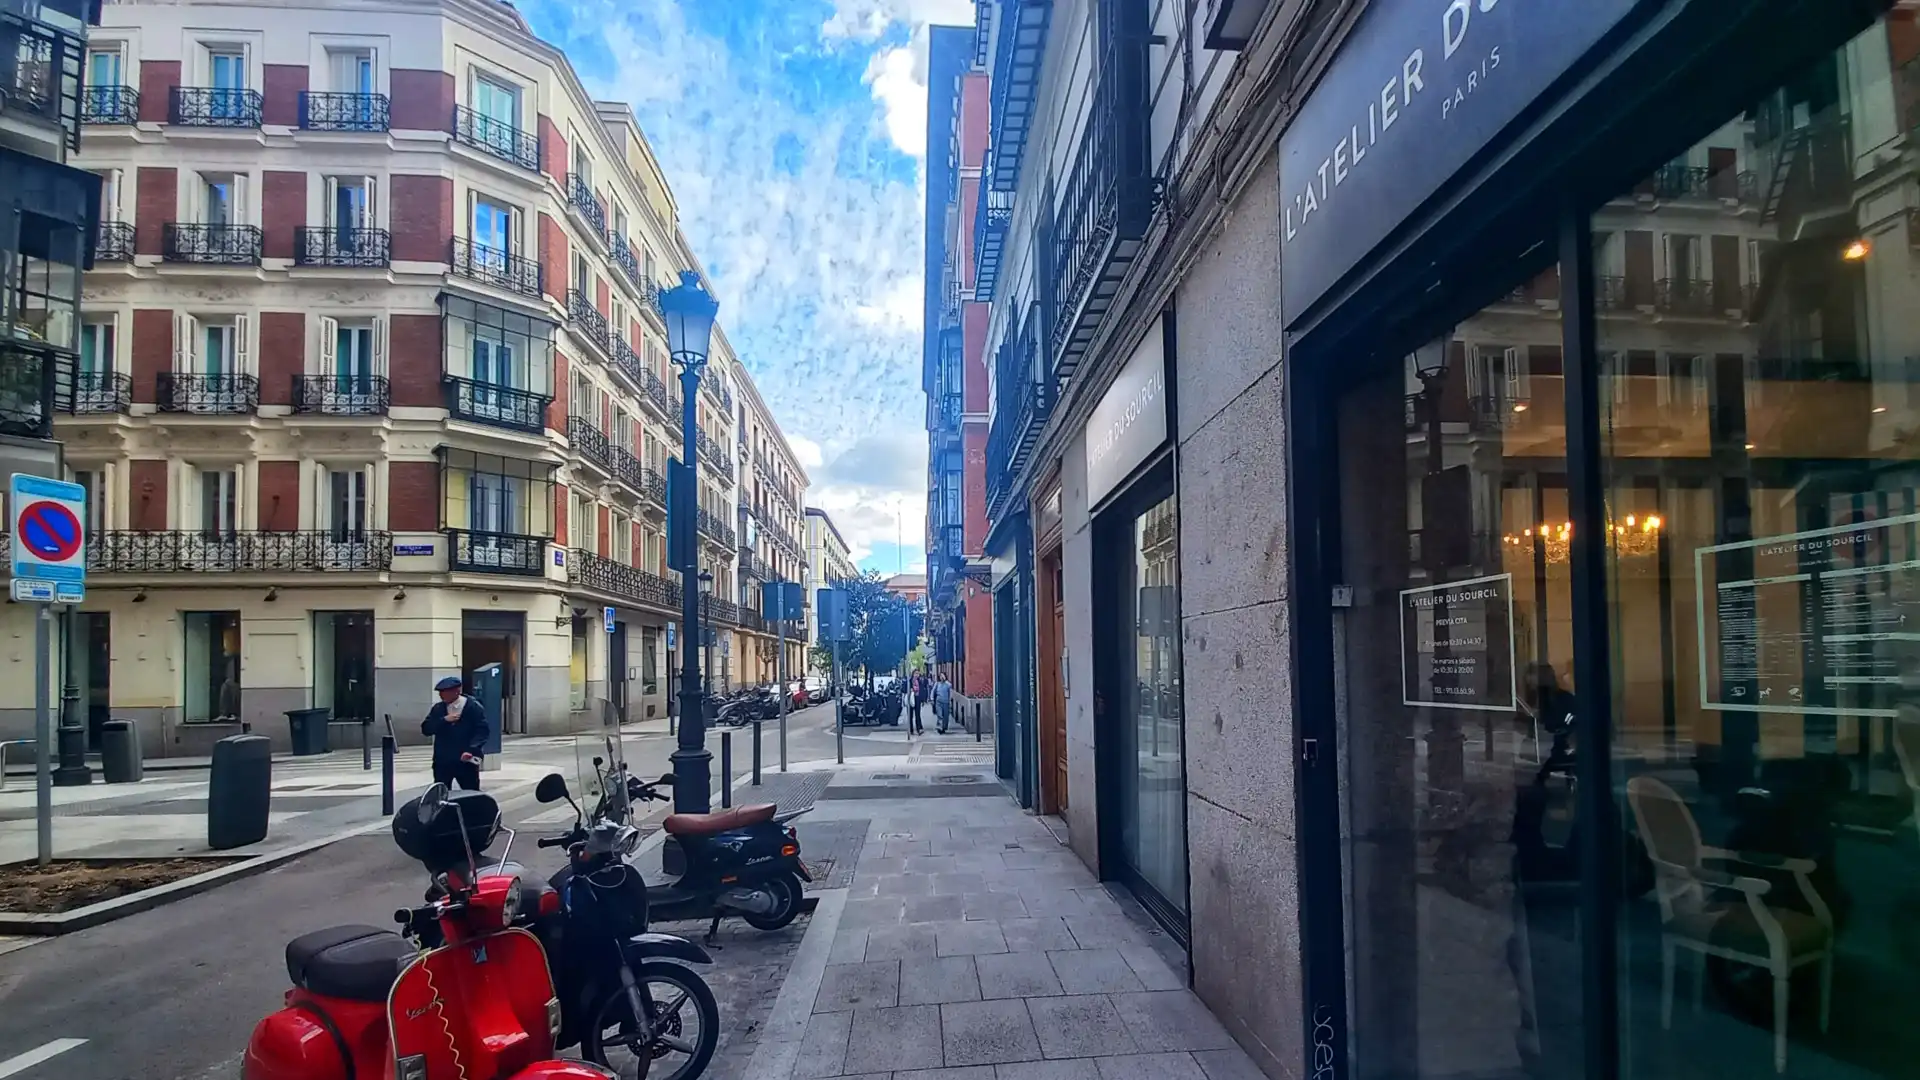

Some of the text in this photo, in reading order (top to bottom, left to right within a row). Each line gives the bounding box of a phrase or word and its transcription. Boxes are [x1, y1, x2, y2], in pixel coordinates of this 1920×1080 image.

[1443, 46, 1500, 120] PARIS
[1286, 0, 1500, 242] L'ATELIER D
[1114, 415, 1125, 441] DU
[1126, 369, 1162, 428] SOURCIL
[1761, 534, 1874, 556] L'ATELIER DU SOURCIL
[1409, 588, 1498, 608] L'ATELIER DU SOURCIL
[1436, 617, 1468, 626] PREVIA CITA
[491, 667, 500, 677] P
[1458, 666, 1474, 674] 20:00
